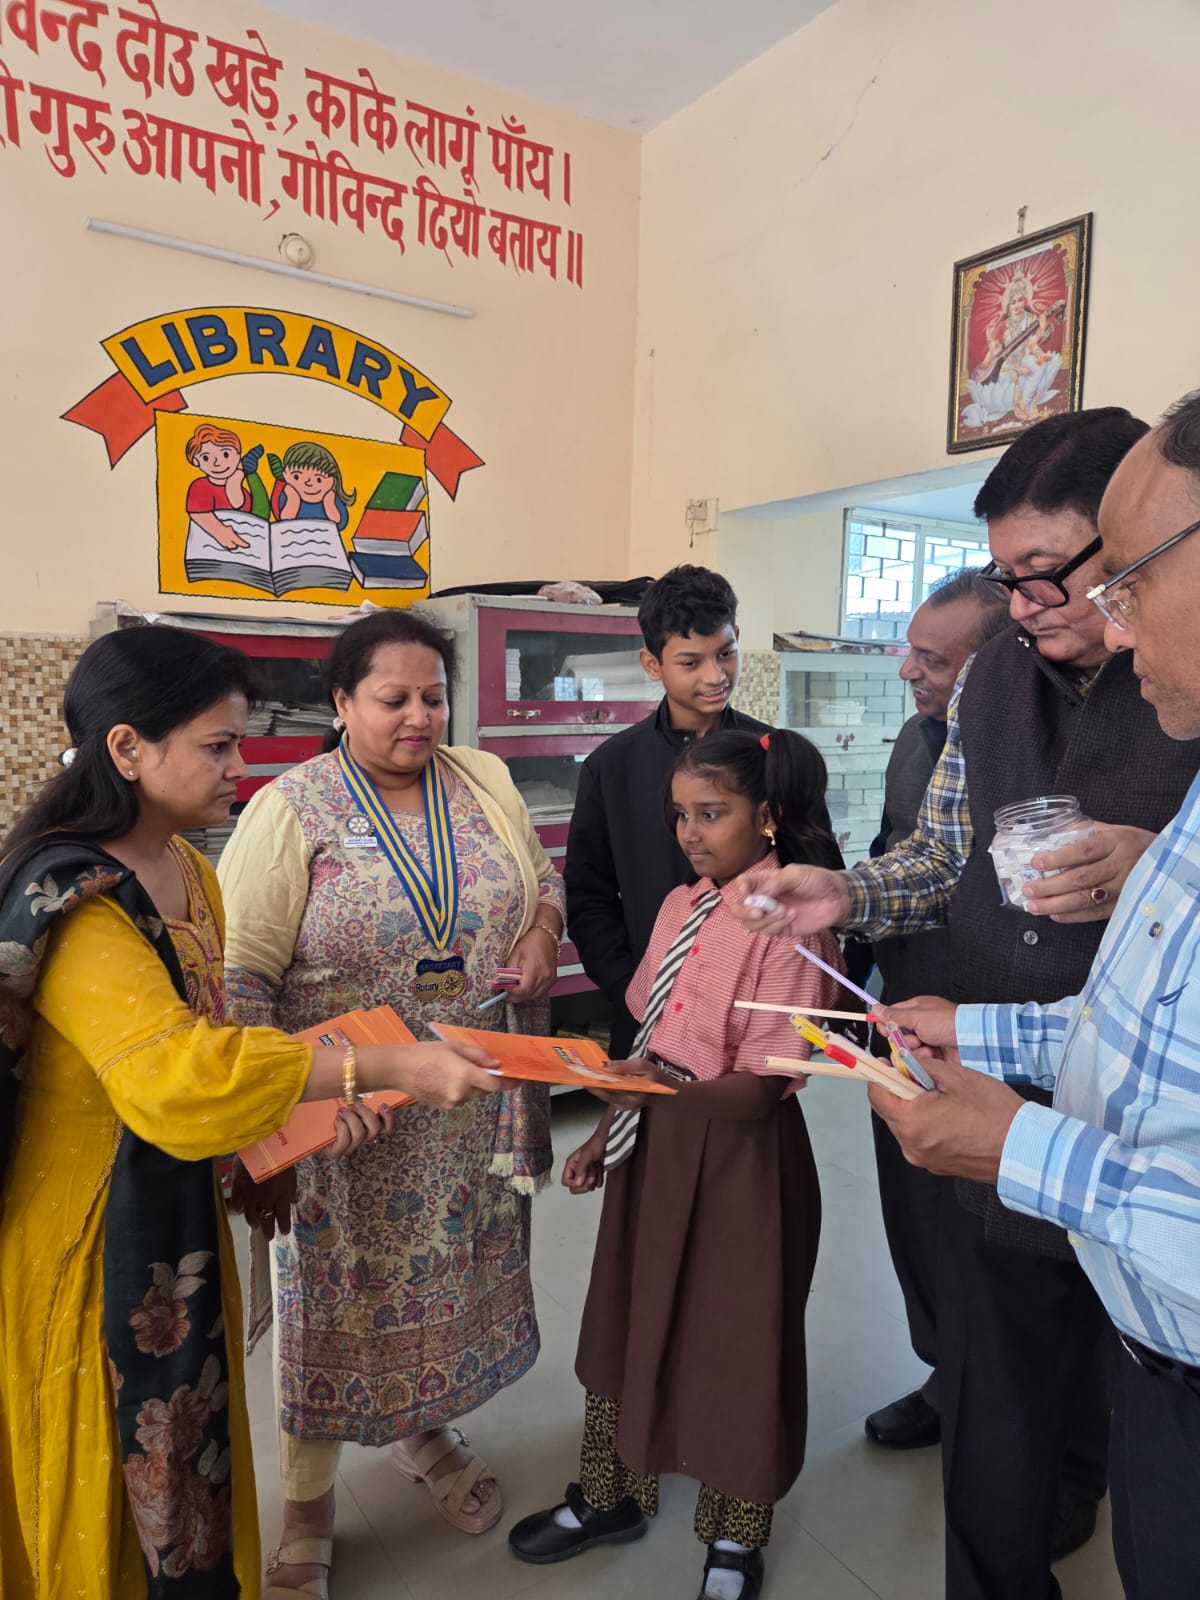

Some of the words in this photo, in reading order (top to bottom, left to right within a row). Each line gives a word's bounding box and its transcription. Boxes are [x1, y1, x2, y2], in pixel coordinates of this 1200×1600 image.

[304, 67, 398, 154] काके
[411, 174, 486, 268] दियो
[487, 208, 562, 281] बताय
[120, 311, 440, 419] LIBRARY
